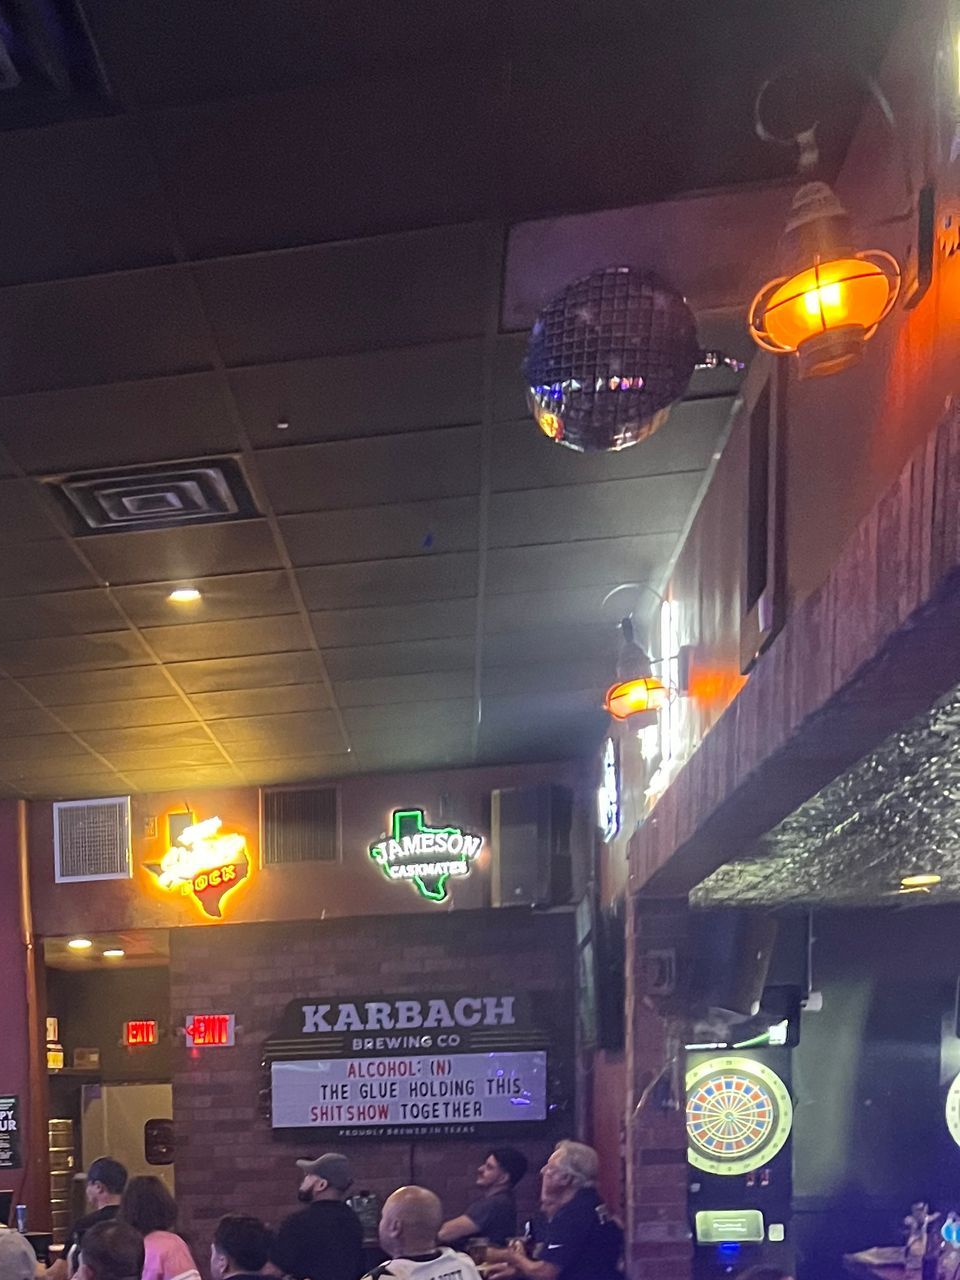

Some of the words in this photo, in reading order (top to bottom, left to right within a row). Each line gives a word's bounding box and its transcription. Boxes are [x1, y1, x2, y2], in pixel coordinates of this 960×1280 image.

[372, 833, 481, 864] JAMESON
[390, 861, 467, 876] CASKMATES
[302, 996, 516, 1033] KARBACH
[128, 1021, 155, 1043] EXIT
[194, 1014, 229, 1044] EXIT
[352, 1035, 433, 1051] BREWING
[437, 1034, 461, 1047] CO
[347, 1060, 422, 1078] ALCOHOL:
[430, 1060, 452, 1077] (N)
[321, 1084, 349, 1100] THE
[359, 1082, 398, 1099] GLUE
[409, 1080, 475, 1097] HOLDING
[487, 1078, 521, 1095] THIS
[311, 1104, 389, 1122] SHITSHOW
[400, 1101, 483, 1119] TOGETHER
